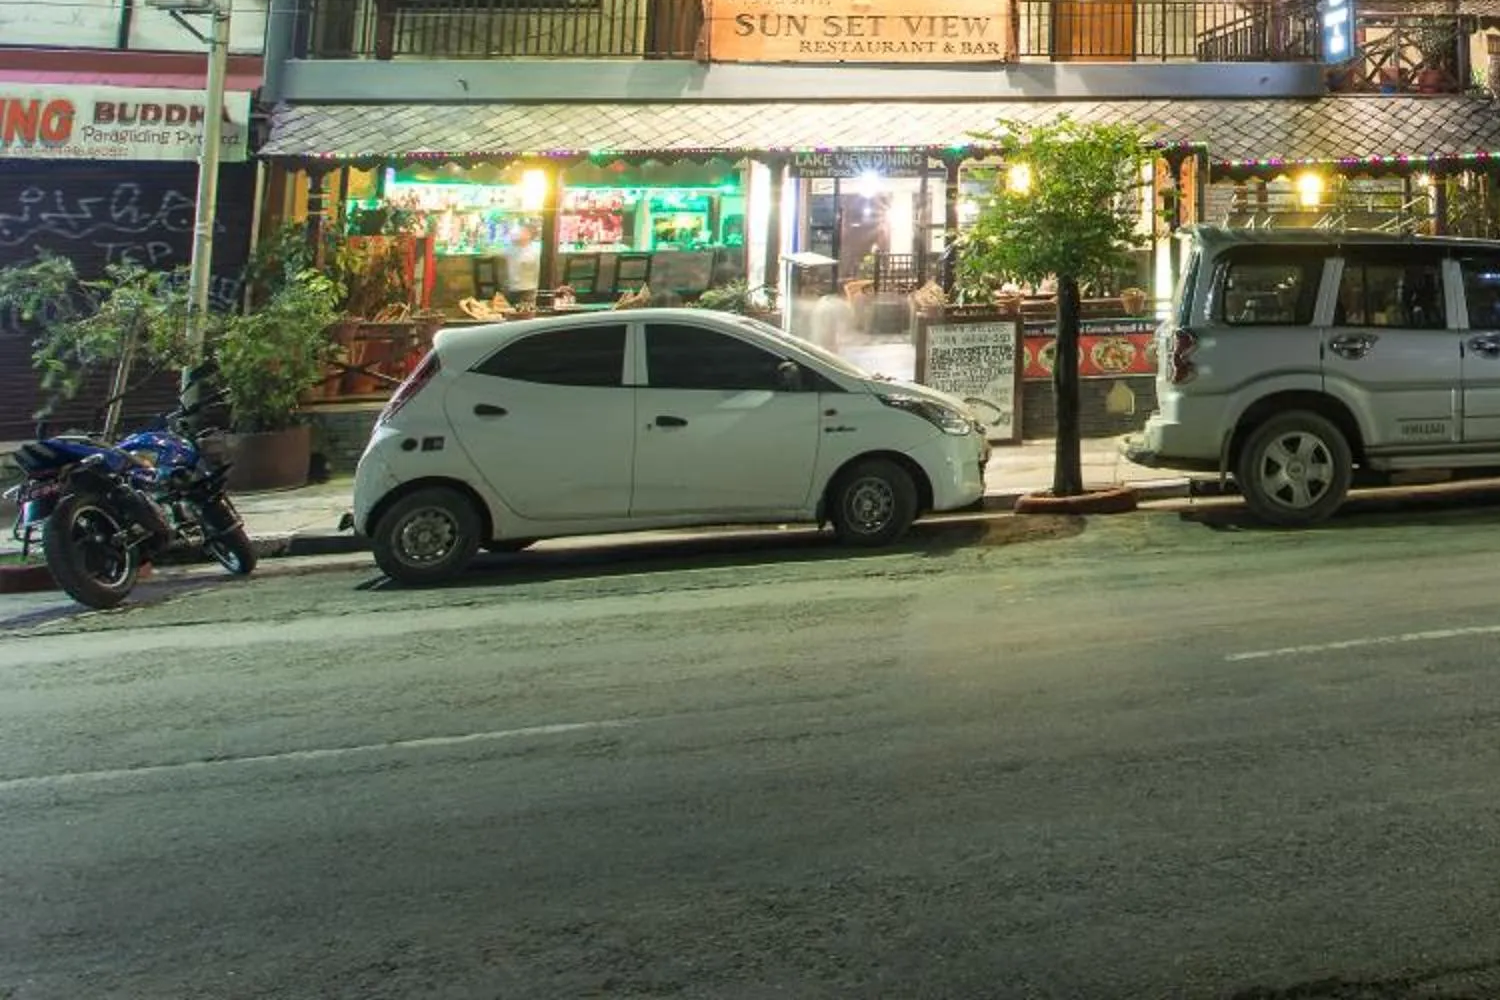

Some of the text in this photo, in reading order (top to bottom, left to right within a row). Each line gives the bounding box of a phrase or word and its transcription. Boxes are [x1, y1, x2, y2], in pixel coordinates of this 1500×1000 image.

[735, 13, 991, 37] SUN SET VIEW
[799, 41, 1001, 54] RESTAURANT & BAR
[93, 101, 232, 124] BUDDH
[81, 126, 171, 145] Paragliding
[795, 153, 832, 166] LAKE
